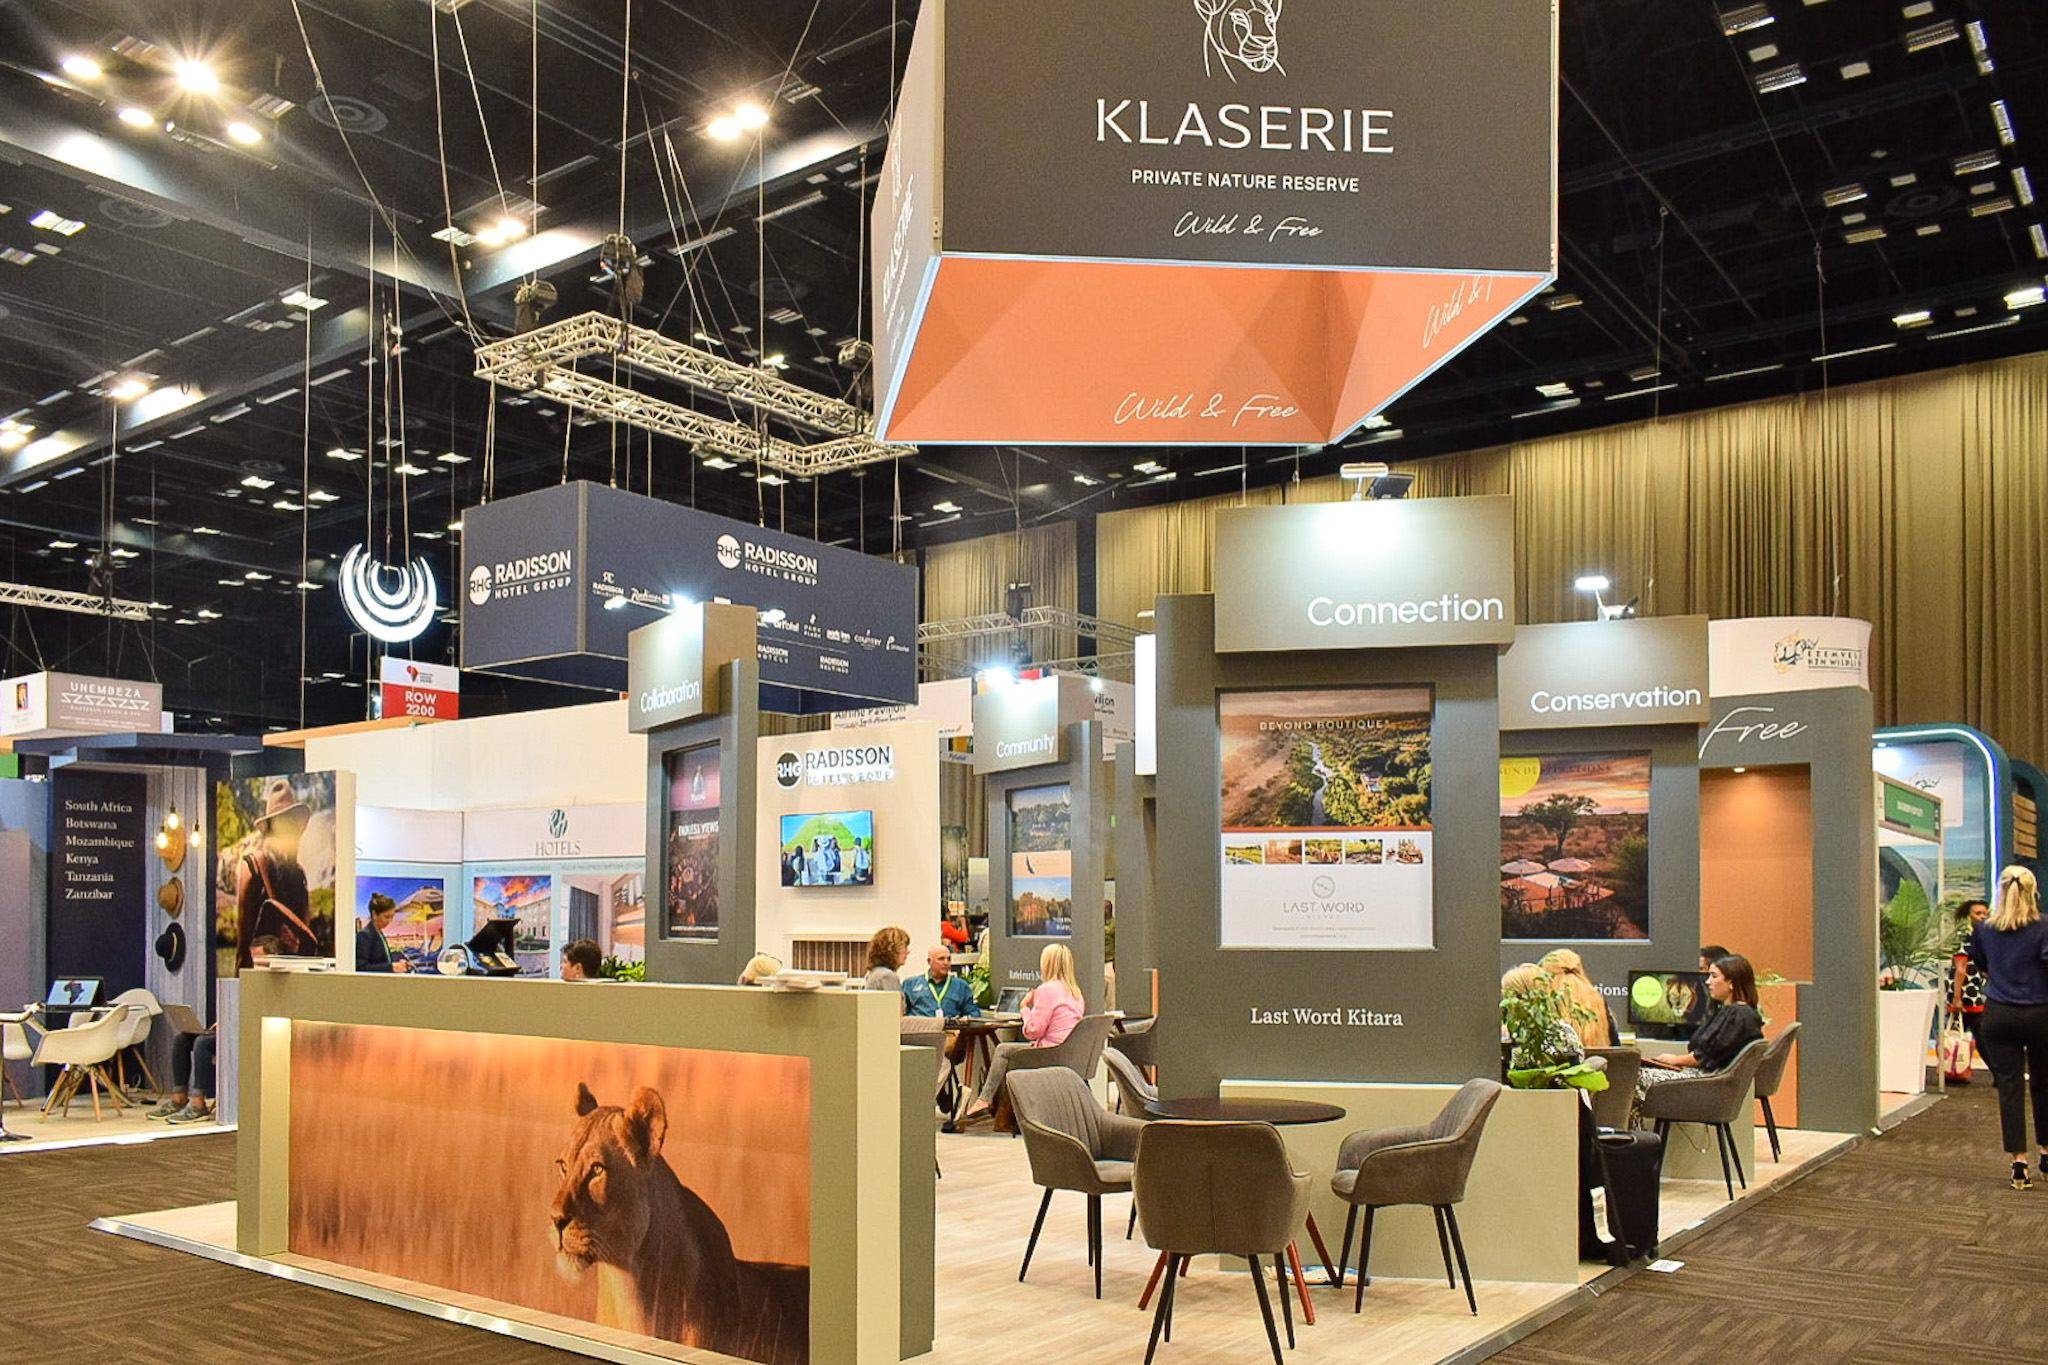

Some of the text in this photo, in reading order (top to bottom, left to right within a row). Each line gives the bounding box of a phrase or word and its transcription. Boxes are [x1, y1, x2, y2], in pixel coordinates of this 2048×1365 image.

[1096, 98, 1394, 153] KLASERIE
[1131, 169, 1360, 193] PRIVATE NATURE RESERVE
[1173, 211, 1324, 243] Wild & Free
[1422, 280, 1466, 349] Wild
[1113, 392, 1299, 427] Wild & Free
[495, 549, 571, 584] RADISSON
[744, 541, 818, 575] RADISSON
[744, 562, 818, 586] HOTEL GROUP
[494, 576, 571, 600] HOTEL GROUP
[1307, 593, 1504, 627] Connection
[70, 681, 141, 698] UNEMBEZA
[405, 690, 437, 705] ROW
[640, 680, 700, 714] Collaboration
[1530, 686, 1701, 713] Conservation
[406, 703, 436, 718] 2200
[1259, 718, 1384, 731] BEYOND BOUTIQUE
[1698, 706, 1808, 760] Free
[995, 733, 1055, 758] Community
[806, 746, 890, 770] RADISSON
[65, 800, 133, 813] South Africa
[66, 817, 118, 830] Botswana
[65, 835, 135, 850] Mozambique
[535, 840, 581, 857] HOTELS
[66, 852, 99, 867] Kenya
[65, 870, 115, 882] Tanzania
[65, 887, 115, 900] Zanzibar
[1282, 901, 1365, 914] LAST WORD
[1250, 1007, 1404, 1026] Last Word Kitara
